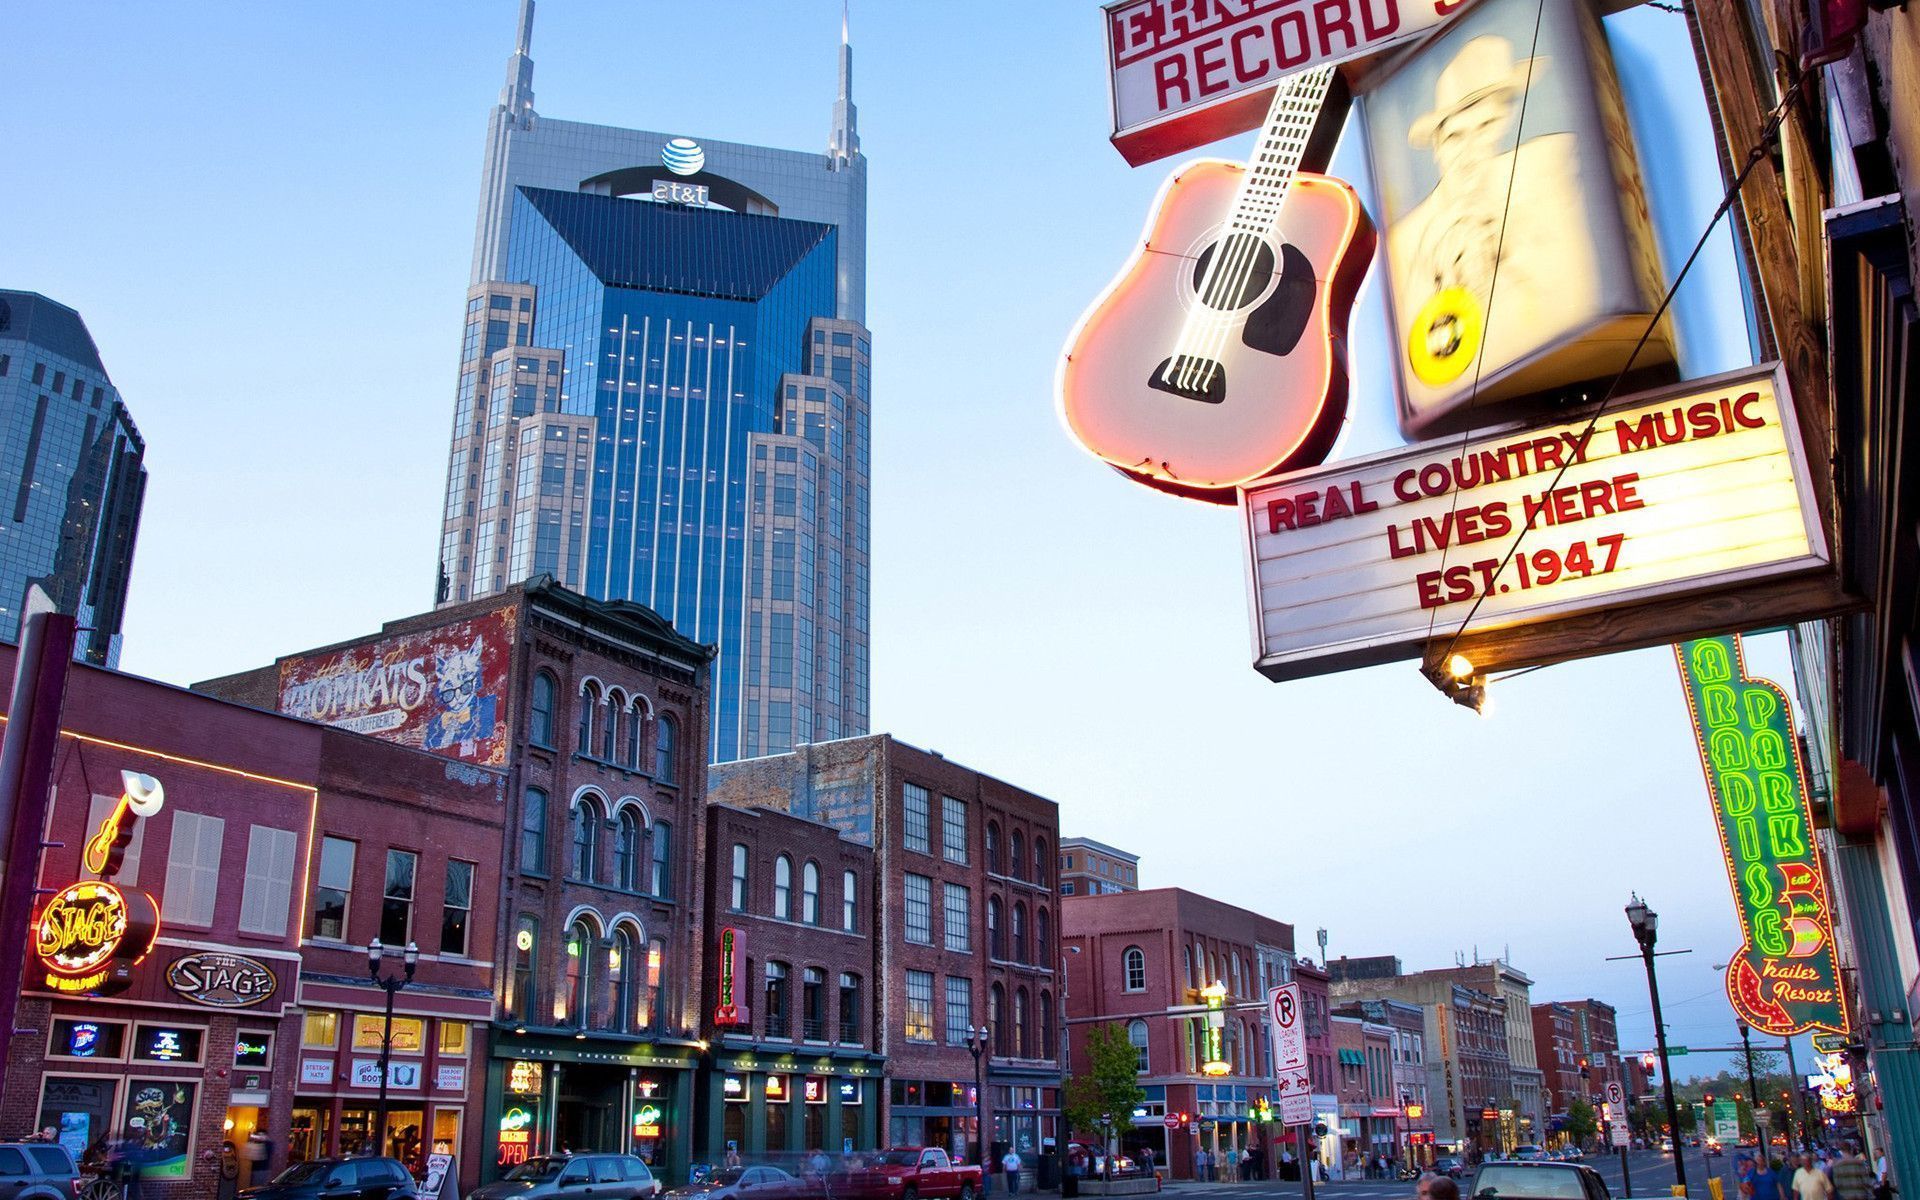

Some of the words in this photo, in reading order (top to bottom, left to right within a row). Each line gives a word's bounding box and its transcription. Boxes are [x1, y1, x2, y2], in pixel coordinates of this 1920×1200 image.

[1154, 0, 1400, 111] RECORD
[653, 182, 707, 205] at&t
[1267, 480, 1378, 534] REAL
[1393, 428, 1595, 503] COUNTRY
[1616, 391, 1767, 454] MUSIC
[1387, 502, 1512, 560] LIVES
[1523, 472, 1647, 531] HERE
[1692, 638, 1788, 957] ARADISE
[1743, 688, 1804, 858] PARK
[38, 898, 124, 956] STAGE
[173, 957, 273, 995] STAGE
[1763, 957, 1821, 981] Trailer
[1773, 981, 1833, 1003] Resort
[362, 1074, 385, 1083] BOOT
[1444, 1059, 1456, 1128] PARKING
[498, 1144, 529, 1165] OPEN
